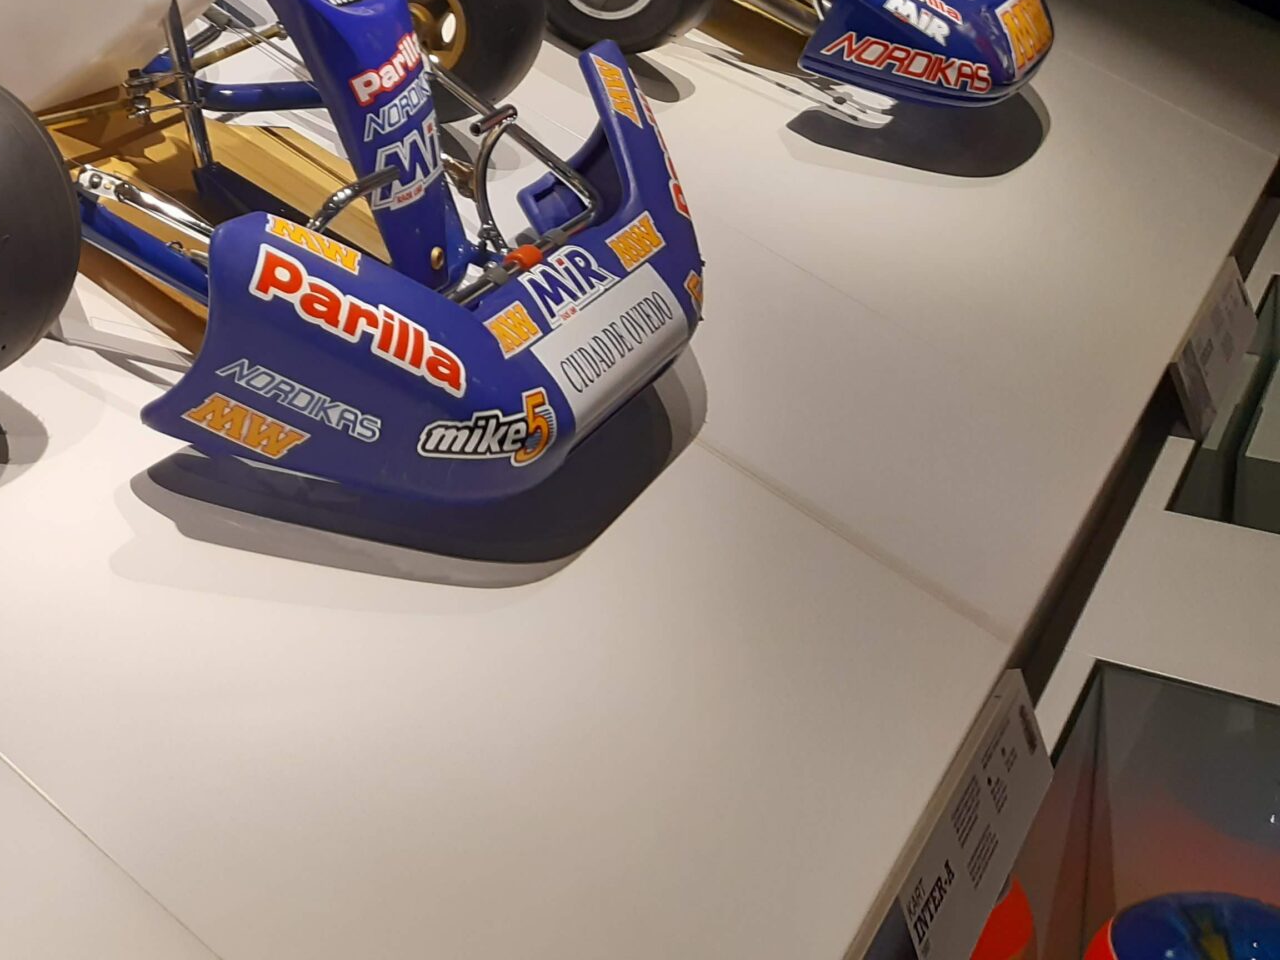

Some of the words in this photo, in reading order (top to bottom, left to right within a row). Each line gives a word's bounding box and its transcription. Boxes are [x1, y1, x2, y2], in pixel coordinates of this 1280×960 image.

[820, 31, 992, 93] NORDIKAS
[267, 215, 361, 274] MW
[606, 211, 665, 271] MW
[252, 246, 464, 395] Parilla
[560, 335, 616, 393] CIUDAD
[601, 321, 634, 358] DE
[620, 291, 673, 344] OVIEDO
[183, 393, 309, 458] MW
[215, 359, 381, 442] NORDIKAS
[906, 878, 926, 922] KART
